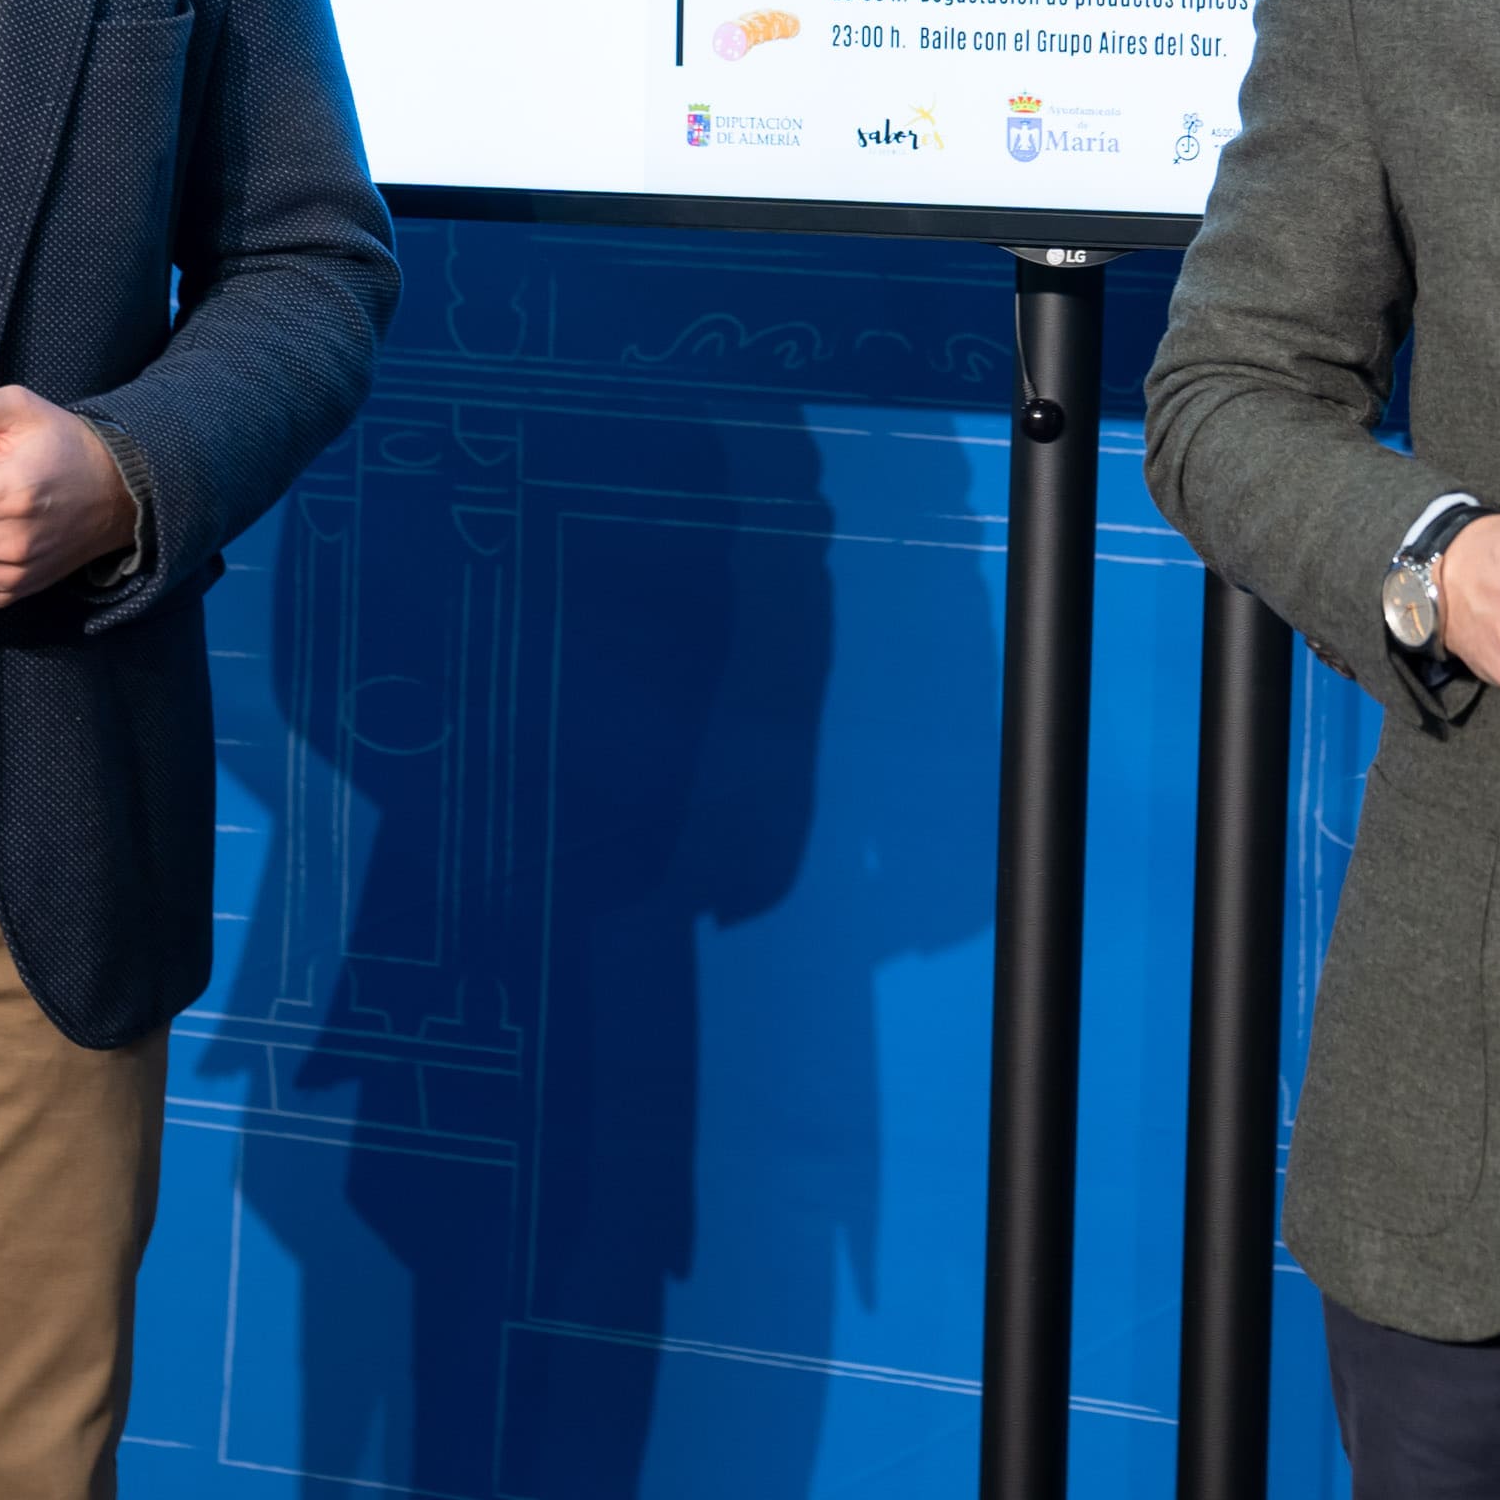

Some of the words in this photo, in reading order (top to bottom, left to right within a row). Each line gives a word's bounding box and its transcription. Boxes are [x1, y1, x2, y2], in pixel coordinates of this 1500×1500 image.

[831, 24, 884, 49] 23:00
[890, 25, 906, 49] h.
[919, 25, 967, 51] Baile
[973, 31, 1007, 52] con
[1013, 28, 1030, 52] el
[1037, 29, 1093, 58] Grupo
[1098, 31, 1148, 56] Aires
[1154, 32, 1184, 57] del
[1190, 33, 1228, 58] Sur.
[715, 115, 803, 131] DIPUTACIÓN
[716, 132, 735, 144] DE
[738, 131, 800, 148] ALMERÍA
[1045, 130, 1121, 154] María
[1065, 250, 1087, 264] LG
